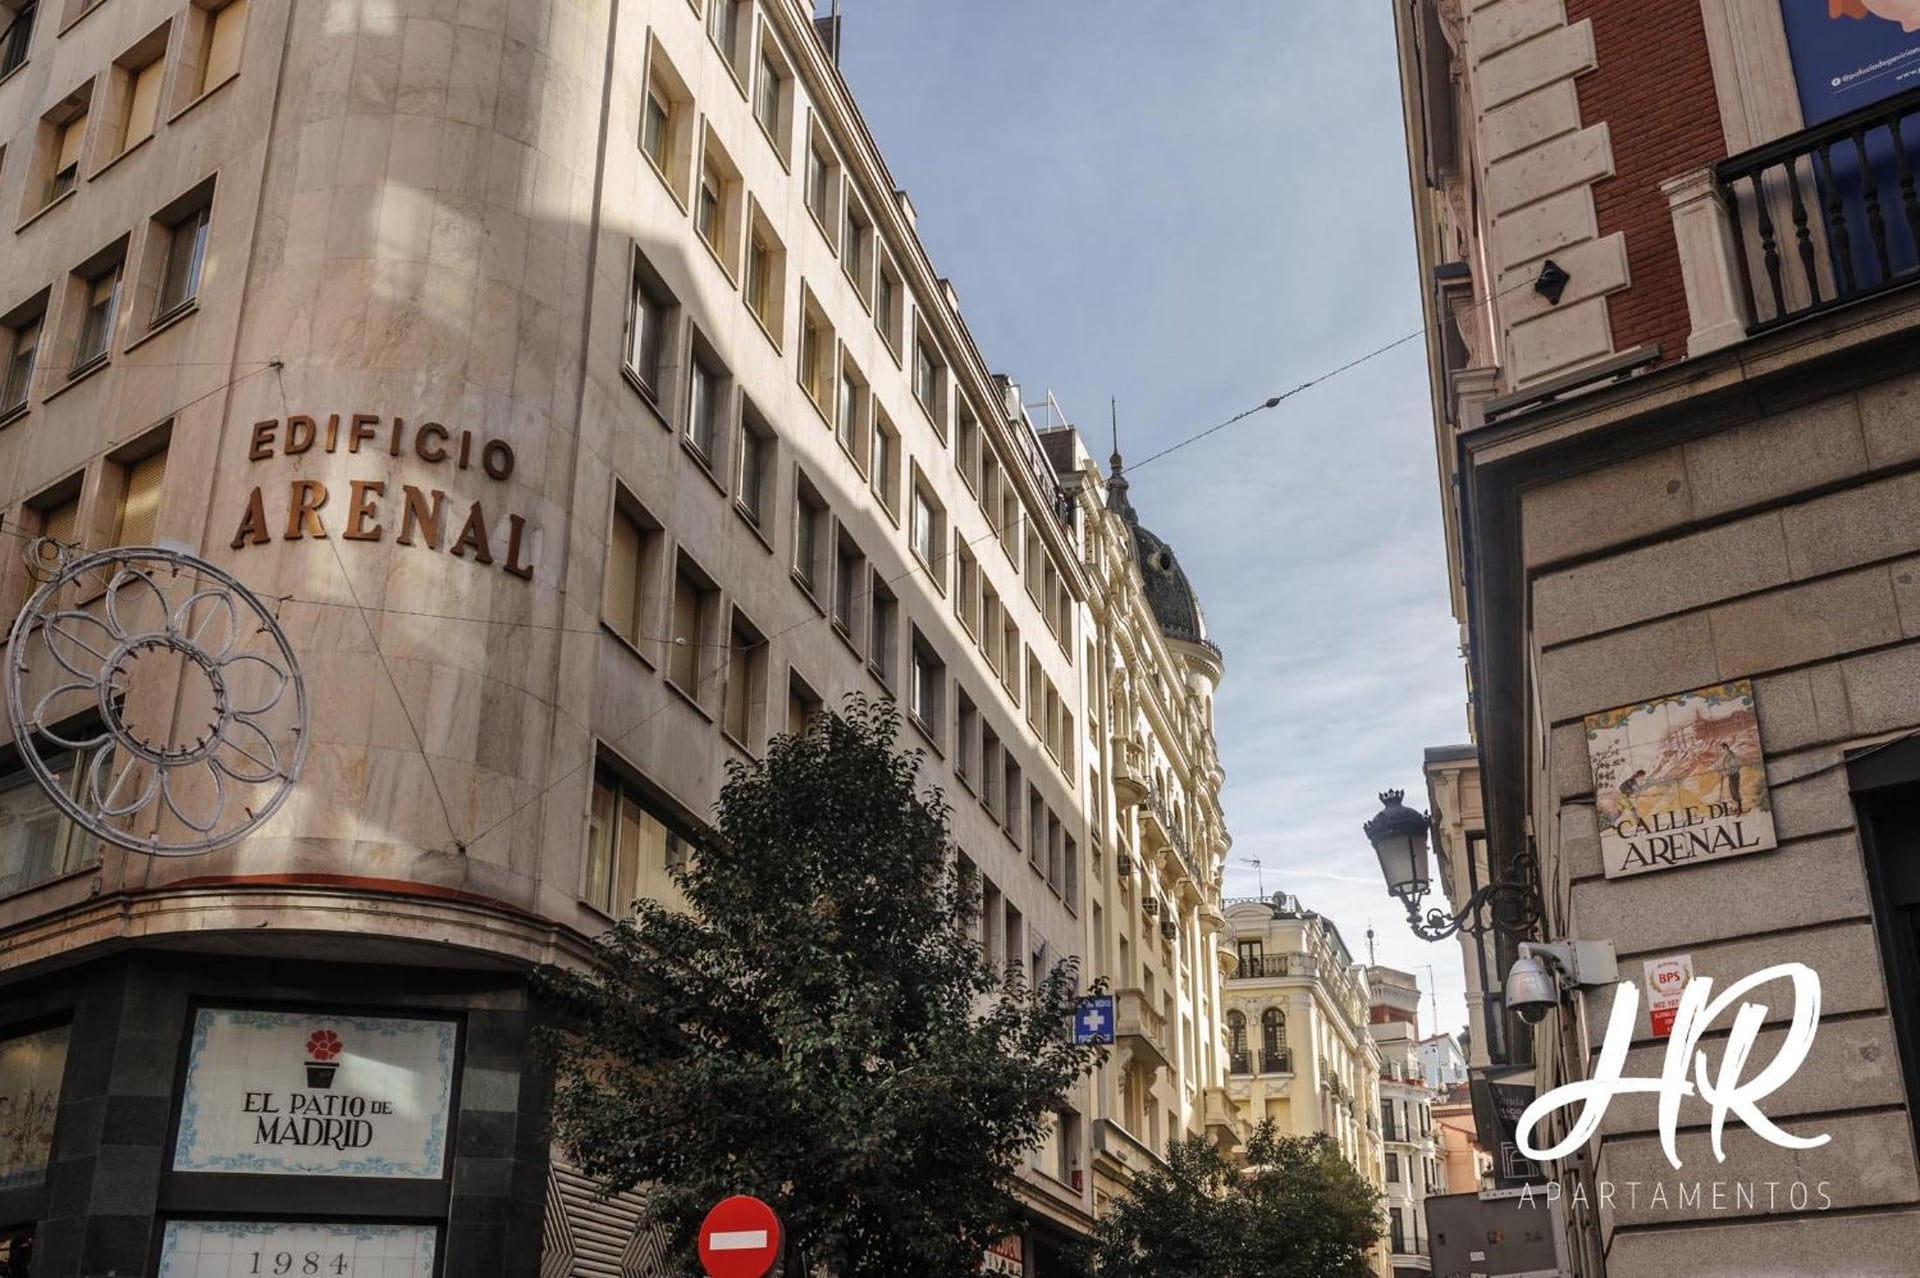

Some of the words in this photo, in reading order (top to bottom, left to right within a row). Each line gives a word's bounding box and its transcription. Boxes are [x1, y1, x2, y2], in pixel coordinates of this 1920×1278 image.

[249, 413, 515, 481] EDIFICIO
[230, 479, 534, 581] ARENAL
[1617, 806, 1704, 839] CALLE
[1708, 800, 1752, 821] DEL
[1618, 821, 1760, 871] ARENAL
[1658, 971, 1681, 984] BPS
[242, 1092, 280, 1113] EL
[289, 1093, 366, 1118] PATIO
[371, 1101, 393, 1115] DE
[253, 1115, 373, 1151] MADRID
[249, 1251, 348, 1275] 1984
